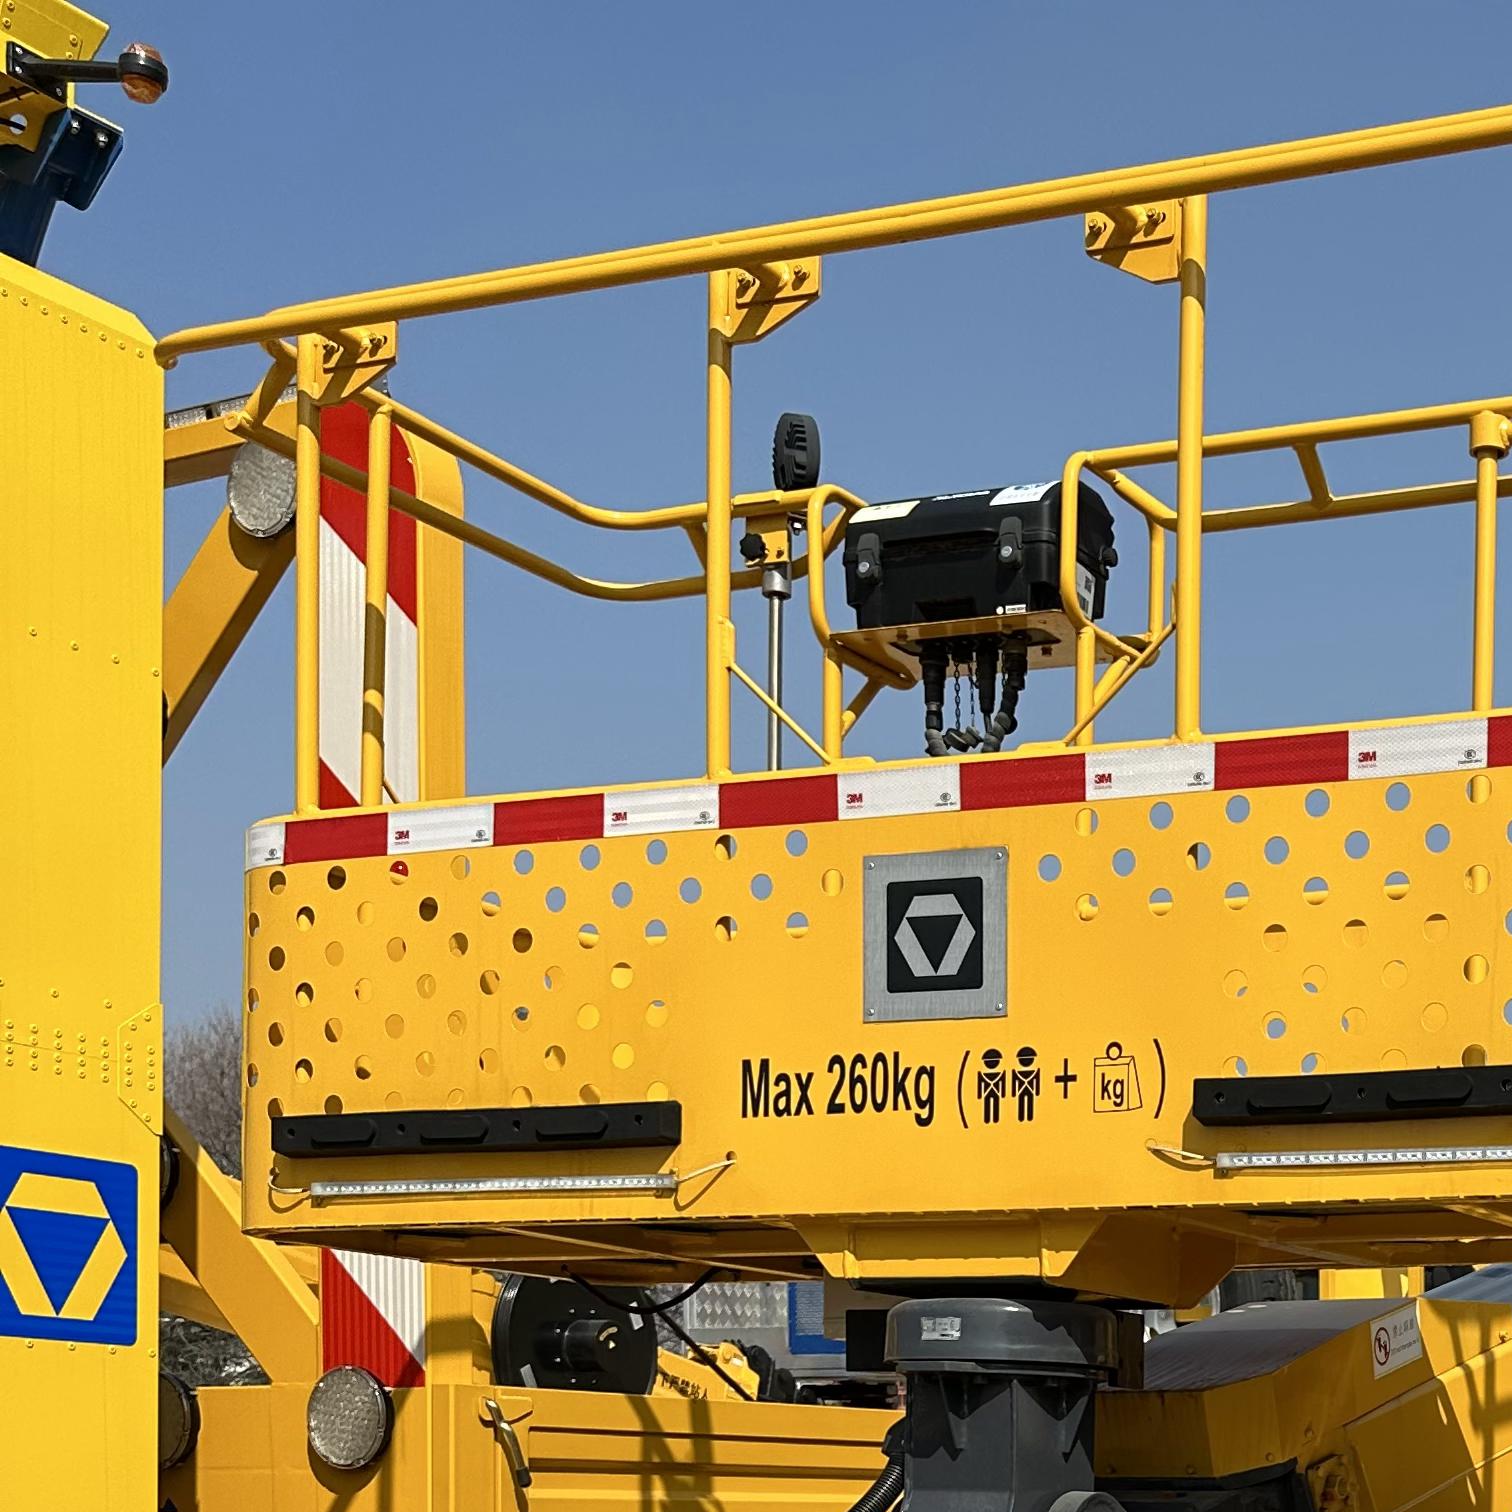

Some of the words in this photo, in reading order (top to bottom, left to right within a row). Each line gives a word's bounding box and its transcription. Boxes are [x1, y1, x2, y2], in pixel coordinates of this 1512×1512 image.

[1358, 751, 1376, 762] 3M
[1095, 774, 1111, 784] 3M
[847, 793, 862, 804] 3M
[612, 812, 627, 821] 3M
[395, 830, 409, 840] 3M
[741, 1058, 814, 1118] Max
[826, 1051, 936, 1127] 260kg
[1100, 1071, 1125, 1108] kg
